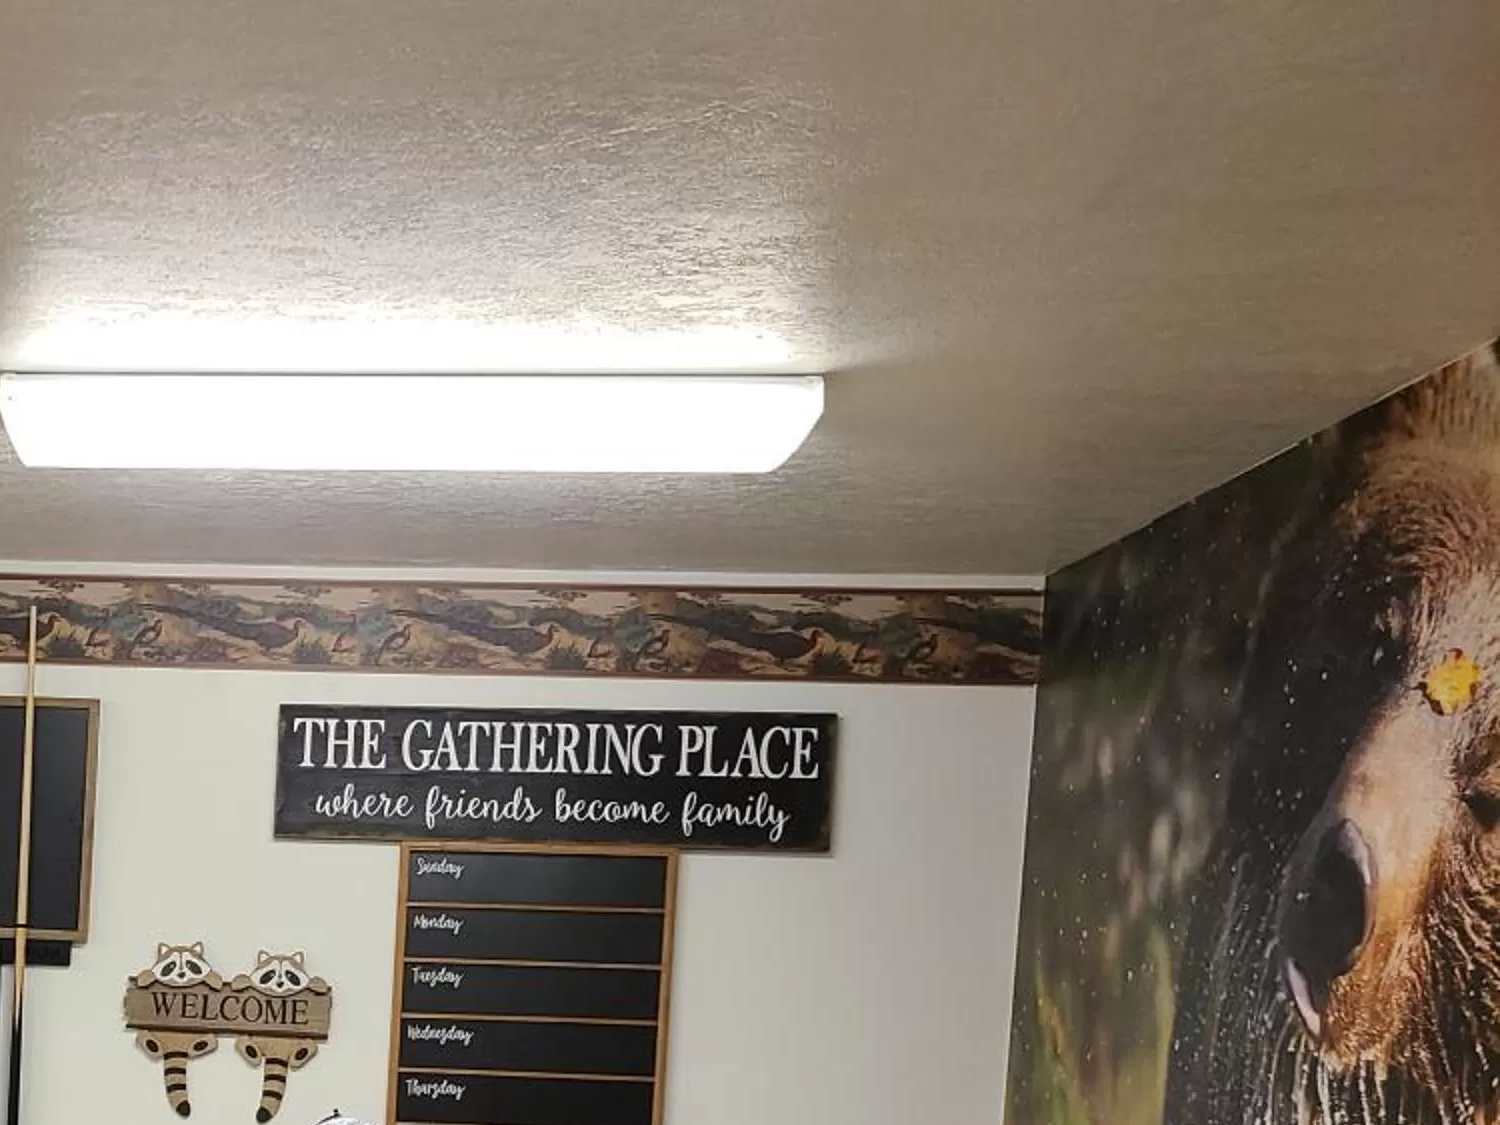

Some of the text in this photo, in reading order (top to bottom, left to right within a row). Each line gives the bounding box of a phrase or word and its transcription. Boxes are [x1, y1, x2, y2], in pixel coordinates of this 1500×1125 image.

[293, 717, 819, 780] THE GATHERING PLACE
[315, 783, 789, 843] where friends become family
[415, 857, 465, 879] Sunday
[413, 913, 464, 935] Monday
[411, 966, 464, 989] Tuesday
[151, 992, 309, 1025] WELCOME
[407, 1024, 474, 1046] Wednesday
[405, 1078, 467, 1100] Thursday
